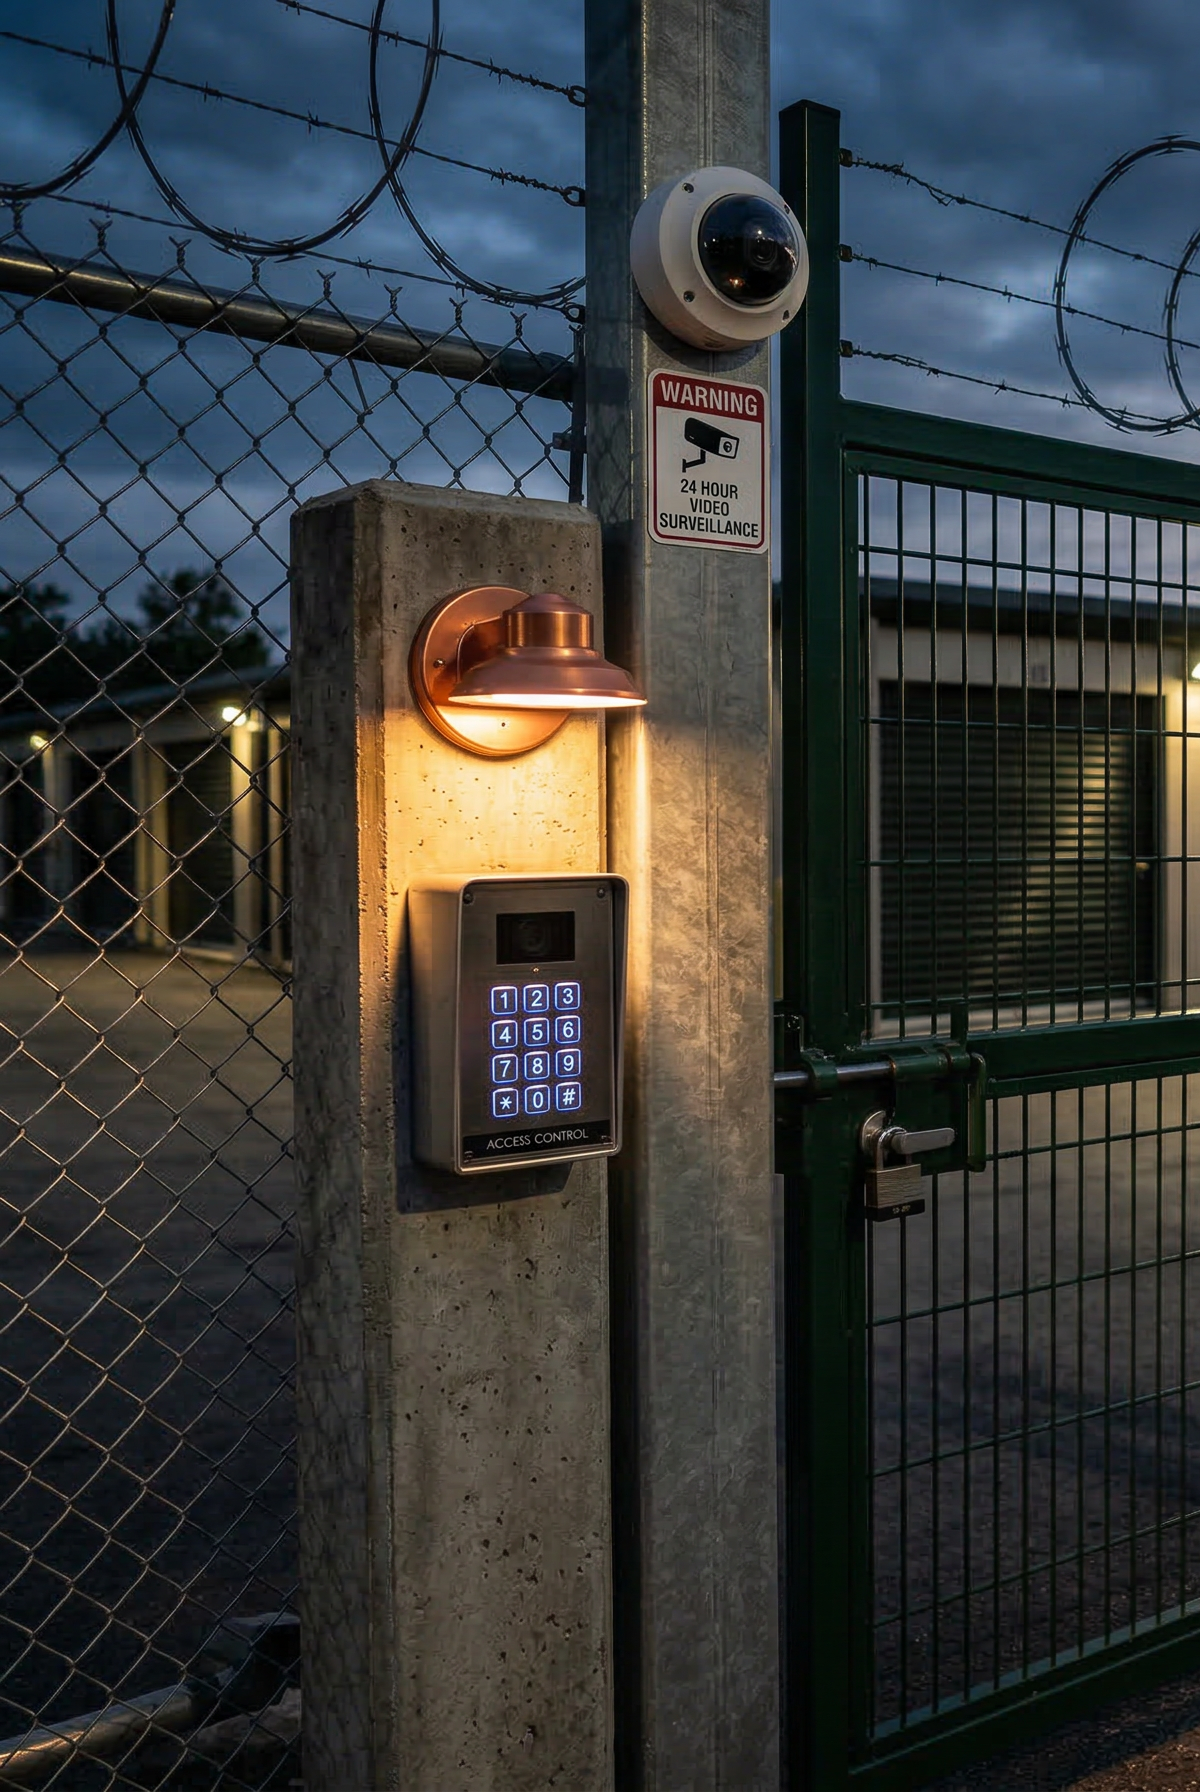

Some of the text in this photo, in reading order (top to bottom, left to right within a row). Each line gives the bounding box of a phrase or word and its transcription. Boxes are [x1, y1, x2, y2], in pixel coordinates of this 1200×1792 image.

[660, 379, 758, 417] WARNING
[680, 478, 738, 500] 24 HOUR
[690, 497, 730, 517] VIDEO
[659, 512, 759, 539] SURVEILLANCE
[500, 988, 573, 1009] 1 2 3
[499, 1021, 574, 1043] 4 5 6
[500, 1054, 574, 1077] 7 8 9
[532, 1091, 543, 1109] 0
[562, 1088, 576, 1105] #
[486, 1128, 589, 1150] ACCESS CONTROL
